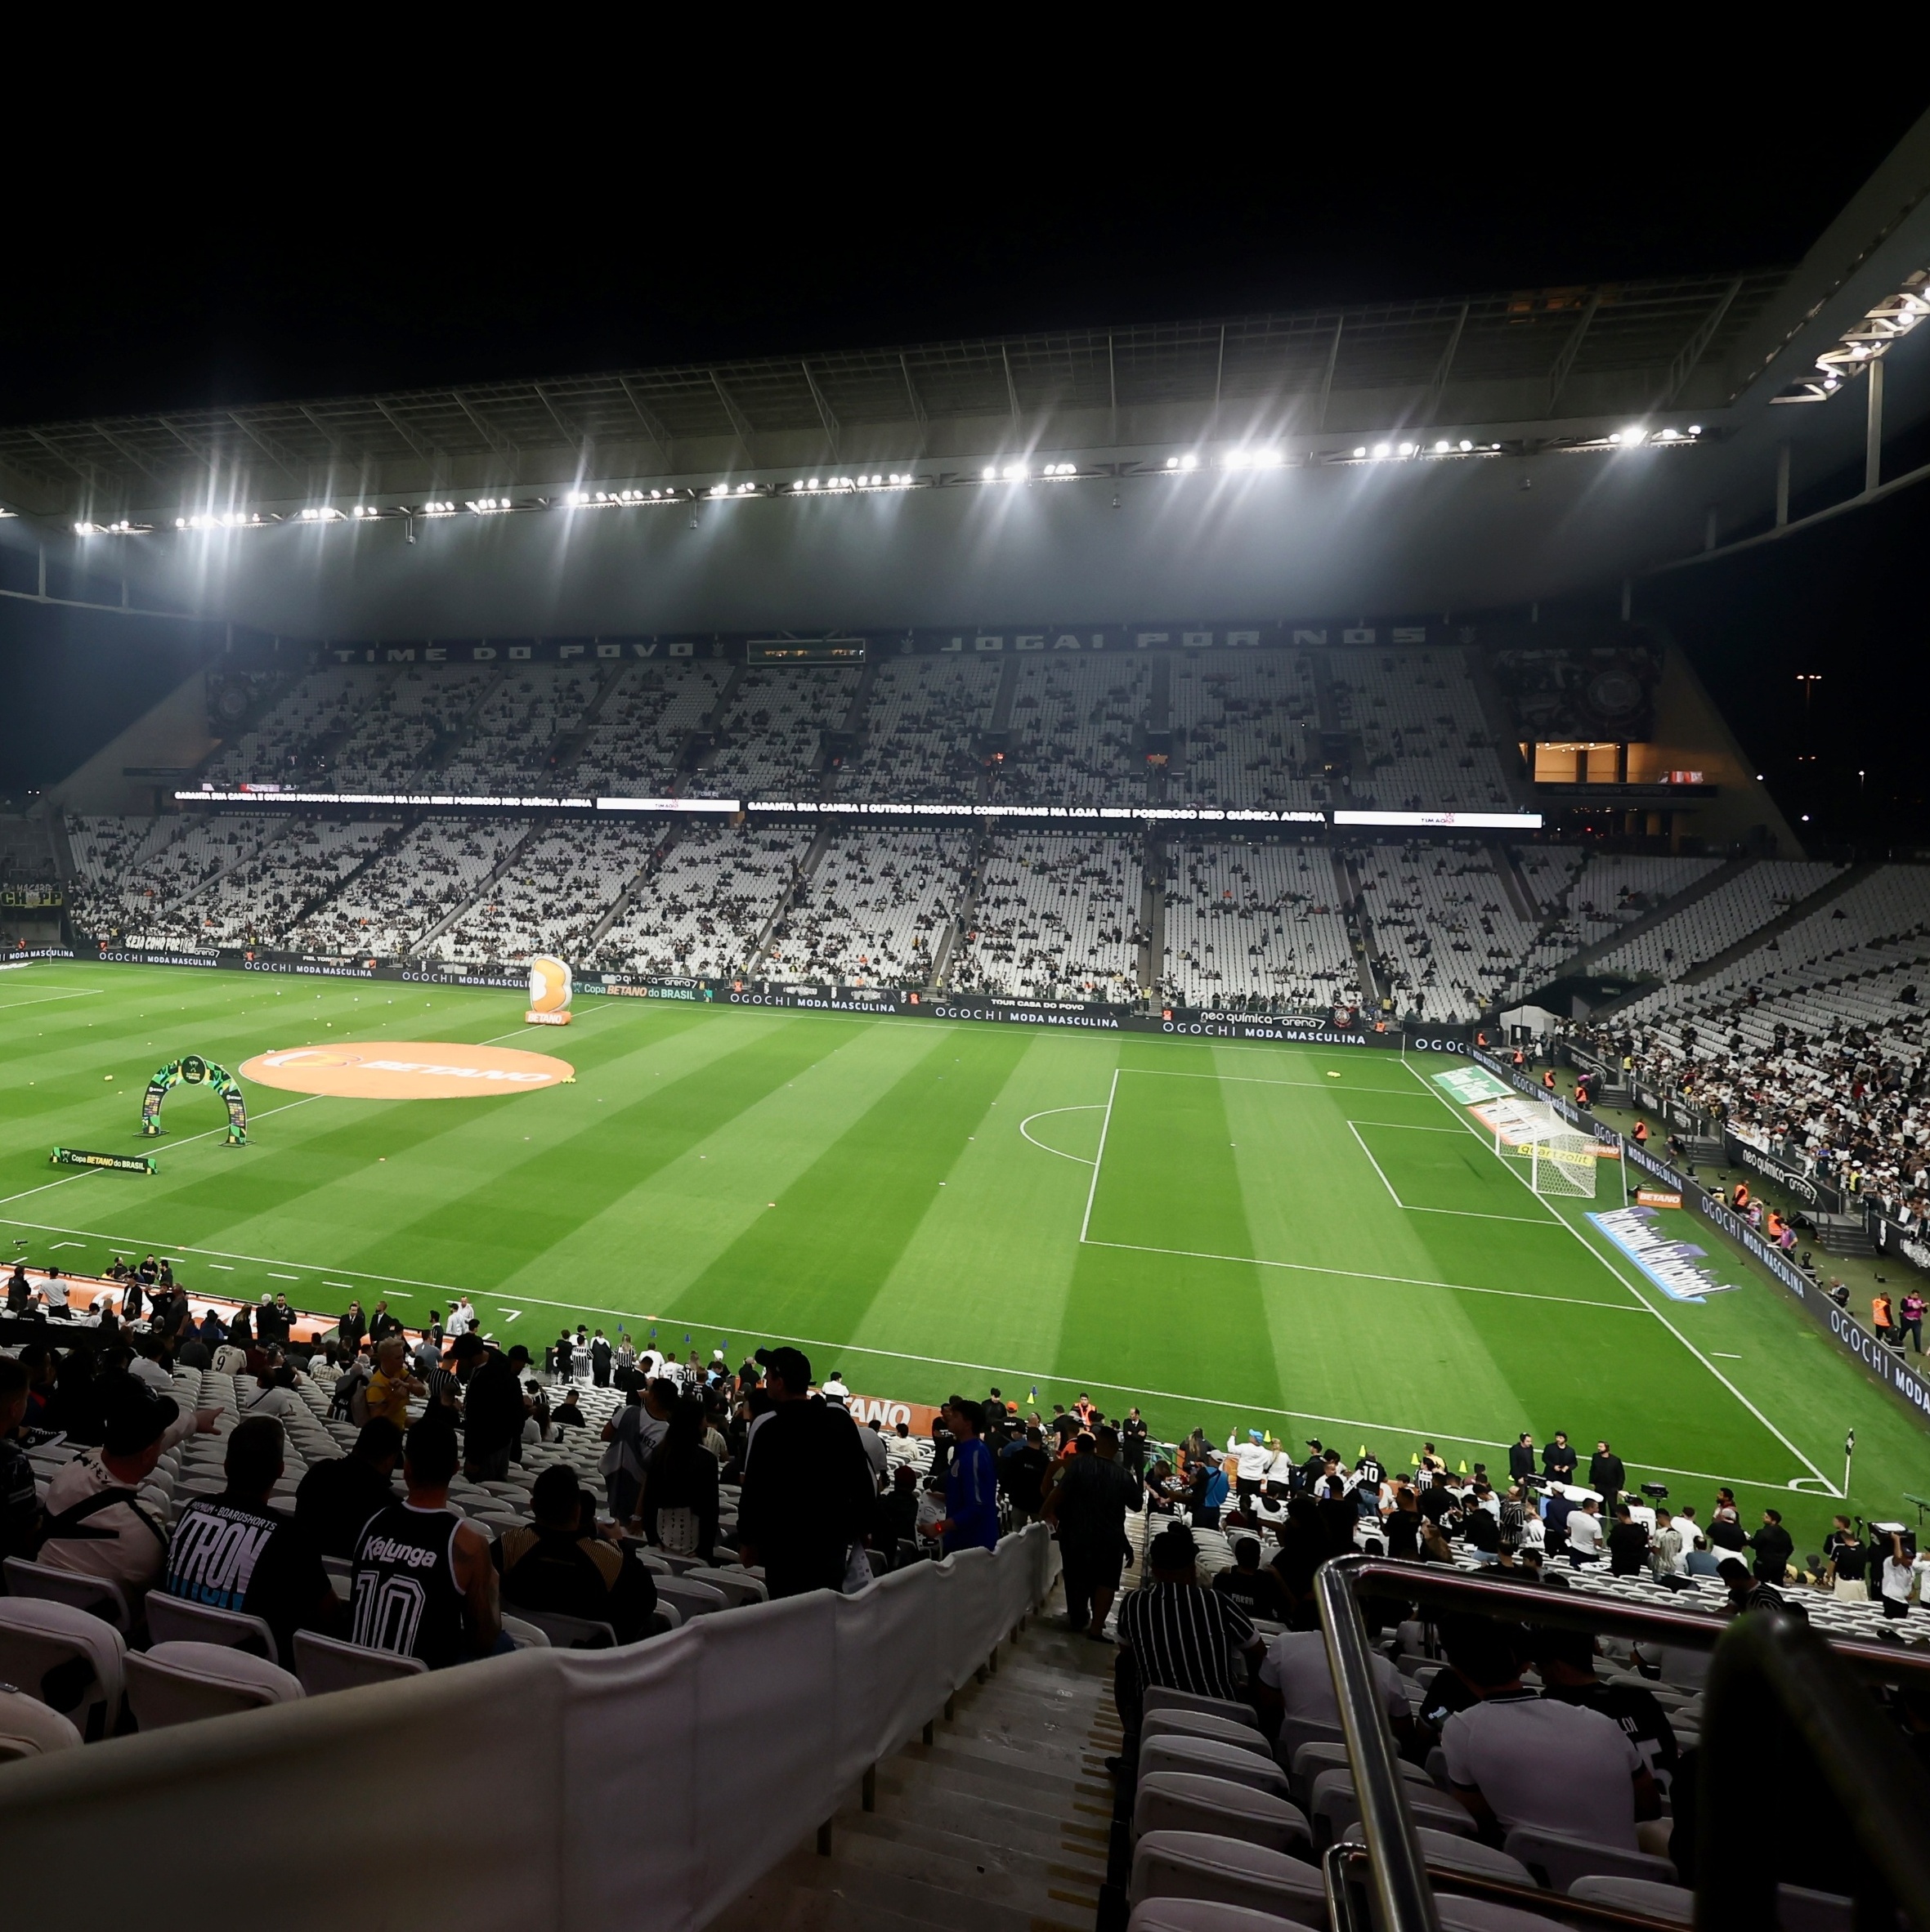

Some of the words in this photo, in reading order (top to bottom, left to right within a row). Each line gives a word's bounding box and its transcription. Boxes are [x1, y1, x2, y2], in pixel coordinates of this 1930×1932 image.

[941, 634, 1104, 651] JOGAI
[1138, 631, 1260, 648] POR
[334, 648, 447, 662] TIME
[473, 646, 531, 660] DO
[560, 643, 694, 659] POVO
[175, 791, 211, 800] GARANTA
[212, 792, 227, 801] SUA
[257, 793, 264, 802] E
[264, 793, 297, 802] OUTROS
[297, 794, 339, 803] PRODUTOS
[340, 794, 395, 804] CORINTHIANS
[395, 795, 408, 804] NA
[409, 796, 430, 805] LOJA
[455, 797, 501, 806] PODEROSO
[502, 798, 521, 807] NEO
[560, 798, 593, 808] ARENA
[747, 802, 796, 812] GARANTA
[797, 802, 818, 812] SUA
[819, 803, 859, 813] CAMISA
[860, 803, 868, 813] E
[869, 803, 912, 814] OUTROS
[914, 804, 972, 815] PRODUTOS
[973, 806, 1049, 816] CORINTHIANS
[1050, 807, 1068, 816] NA
[1069, 807, 1099, 817] LOJA
[1100, 808, 1131, 818] REDE
[1132, 808, 1198, 820] PODEROSO
[1198, 810, 1225, 821] NEO
[1226, 808, 1279, 821] QUÍMICA
[1281, 811, 1325, 822] ARENA
[2, 892, 62, 906] CHPP
[125, 934, 144, 950] SEJA
[145, 935, 164, 951] COMO
[9, 951, 29, 960] MODA
[30, 948, 74, 959] MASCULINA
[99, 951, 143, 963] OGOCHI
[147, 955, 170, 964] MODA
[171, 956, 217, 967] MASCULINA
[195, 949, 214, 957] arena
[244, 961, 292, 973] OGOCHI
[296, 964, 322, 975] MODA
[323, 966, 373, 978] MASCULINA
[402, 971, 454, 984] OGOCHI
[458, 975, 485, 986] MODA
[487, 977, 531, 988] MASCULI
[584, 983, 606, 995] Copa
[607, 985, 647, 997] BETANO
[647, 987, 660, 998] do
[660, 988, 696, 1000] BRASIL
[730, 992, 790, 1007] OGOCHI
[797, 997, 829, 1009] MODA
[831, 1000, 896, 1013] MASCULINA
[991, 998, 1015, 1007] TOUR
[1017, 1000, 1041, 1009] CASA
[1043, 1001, 1060, 1010] DO
[1061, 1002, 1085, 1012] POVO
[527, 1012, 562, 1024] BETANO
[934, 1007, 1002, 1022] OGOCHI
[1010, 1012, 1045, 1023] MODA
[1047, 1014, 1119, 1029] MASCULINA
[1200, 1010, 1224, 1022] neo
[1225, 1013, 1273, 1026] química
[1282, 1017, 1317, 1028] arena
[1162, 1021, 1236, 1037] OGOCHI
[1244, 1027, 1283, 1040] MODA
[1286, 1030, 1367, 1046] MASCULINA
[357, 1059, 553, 1082] BETANO
[1512, 1072, 1537, 1097] OGOCHI
[71, 1154, 86, 1165] Copa
[87, 1155, 113, 1166] BETANO
[113, 1159, 122, 1167] do
[122, 1160, 145, 1171] BRASIL
[1628, 1145, 1646, 1168] MODA
[1646, 1157, 1683, 1192] MASCULINA
[1742, 1148, 1758, 1168] neo
[1757, 1156, 1785, 1183] química
[1639, 1192, 1680, 1204] BETANO
[1702, 1196, 1740, 1241] OGOCHI
[1743, 1229, 1762, 1259] MODA
[1763, 1247, 1804, 1298] MASCULINA
[216, 1355, 226, 1371] 9
[1830, 1310, 1888, 1379] OGOCHI
[1895, 1366, 1930, 1415] MODA
[1363, 1465, 1379, 1483] 10
[217, 1506, 278, 1531] BOARDSHORTS
[352, 1570, 426, 1657] 10
